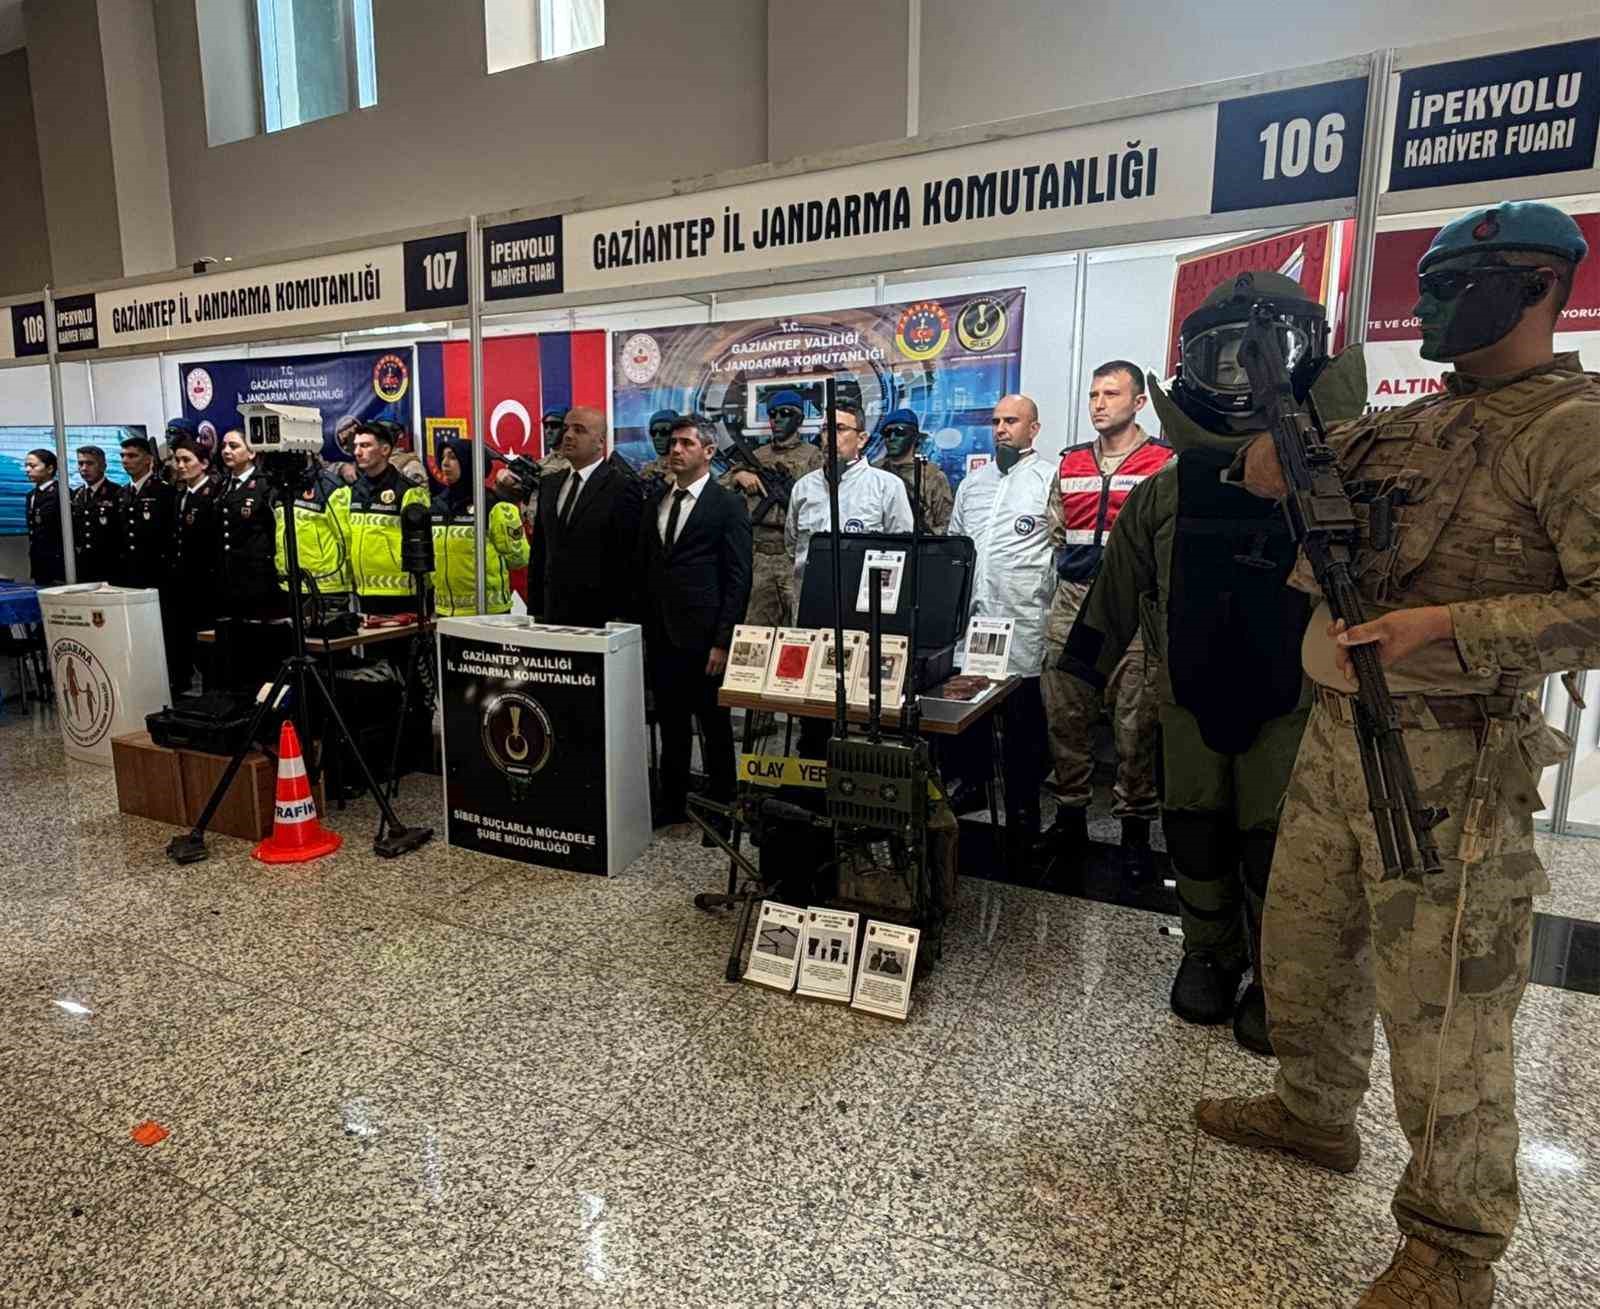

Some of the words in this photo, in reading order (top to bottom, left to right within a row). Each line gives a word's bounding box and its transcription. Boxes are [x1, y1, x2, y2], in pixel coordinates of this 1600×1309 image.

[1408, 71, 1582, 129] İPEKYOLU
[1259, 112, 1345, 181] 106
[1404, 128, 1498, 168] KARİYER
[1504, 117, 1576, 155] FUARI
[592, 220, 716, 271] GAZİANTEP
[723, 206, 745, 254] İL
[753, 186, 911, 249] JANDARMA
[922, 139, 1159, 226] KOMUTANLIĞI
[490, 235, 555, 265] İPEKYOLU
[423, 251, 458, 291] 107
[491, 264, 527, 288] KARİYER
[528, 262, 556, 282] FUARI
[112, 299, 176, 333] GAZİANTEP
[179, 291, 192, 324] İL
[194, 284, 271, 321] JANDARMA
[275, 263, 381, 312] KOMUTANLIĞI
[22, 315, 45, 344] 108
[780, 323, 804, 332] T.C.
[1384, 319, 1399, 328] VE
[725, 356, 791, 371] JANDARMA
[791, 348, 885, 367] KOMUTANLIĞI
[731, 338, 801, 354] GAZİANTEP
[246, 391, 288, 403] JANDARMA
[250, 378, 293, 390] GAZİANTEP
[1375, 378, 1446, 395] ALTIN
[447, 659, 456, 671] İL
[457, 663, 511, 680] JANDARMA
[513, 670, 596, 686] KOMUTANLIĞI
[462, 650, 520, 665] GAZİANTEP
[522, 656, 572, 671] VALİLİĞİ
[747, 760, 784, 778] OLAY
[454, 809, 481, 823] SİBER
[482, 816, 534, 835] SUÇLARLA
[535, 827, 596, 845] MÜCADELE
[477, 828, 503, 842] ŞUBE
[503, 834, 571, 855] MÜDÜRLÜĞÜ
